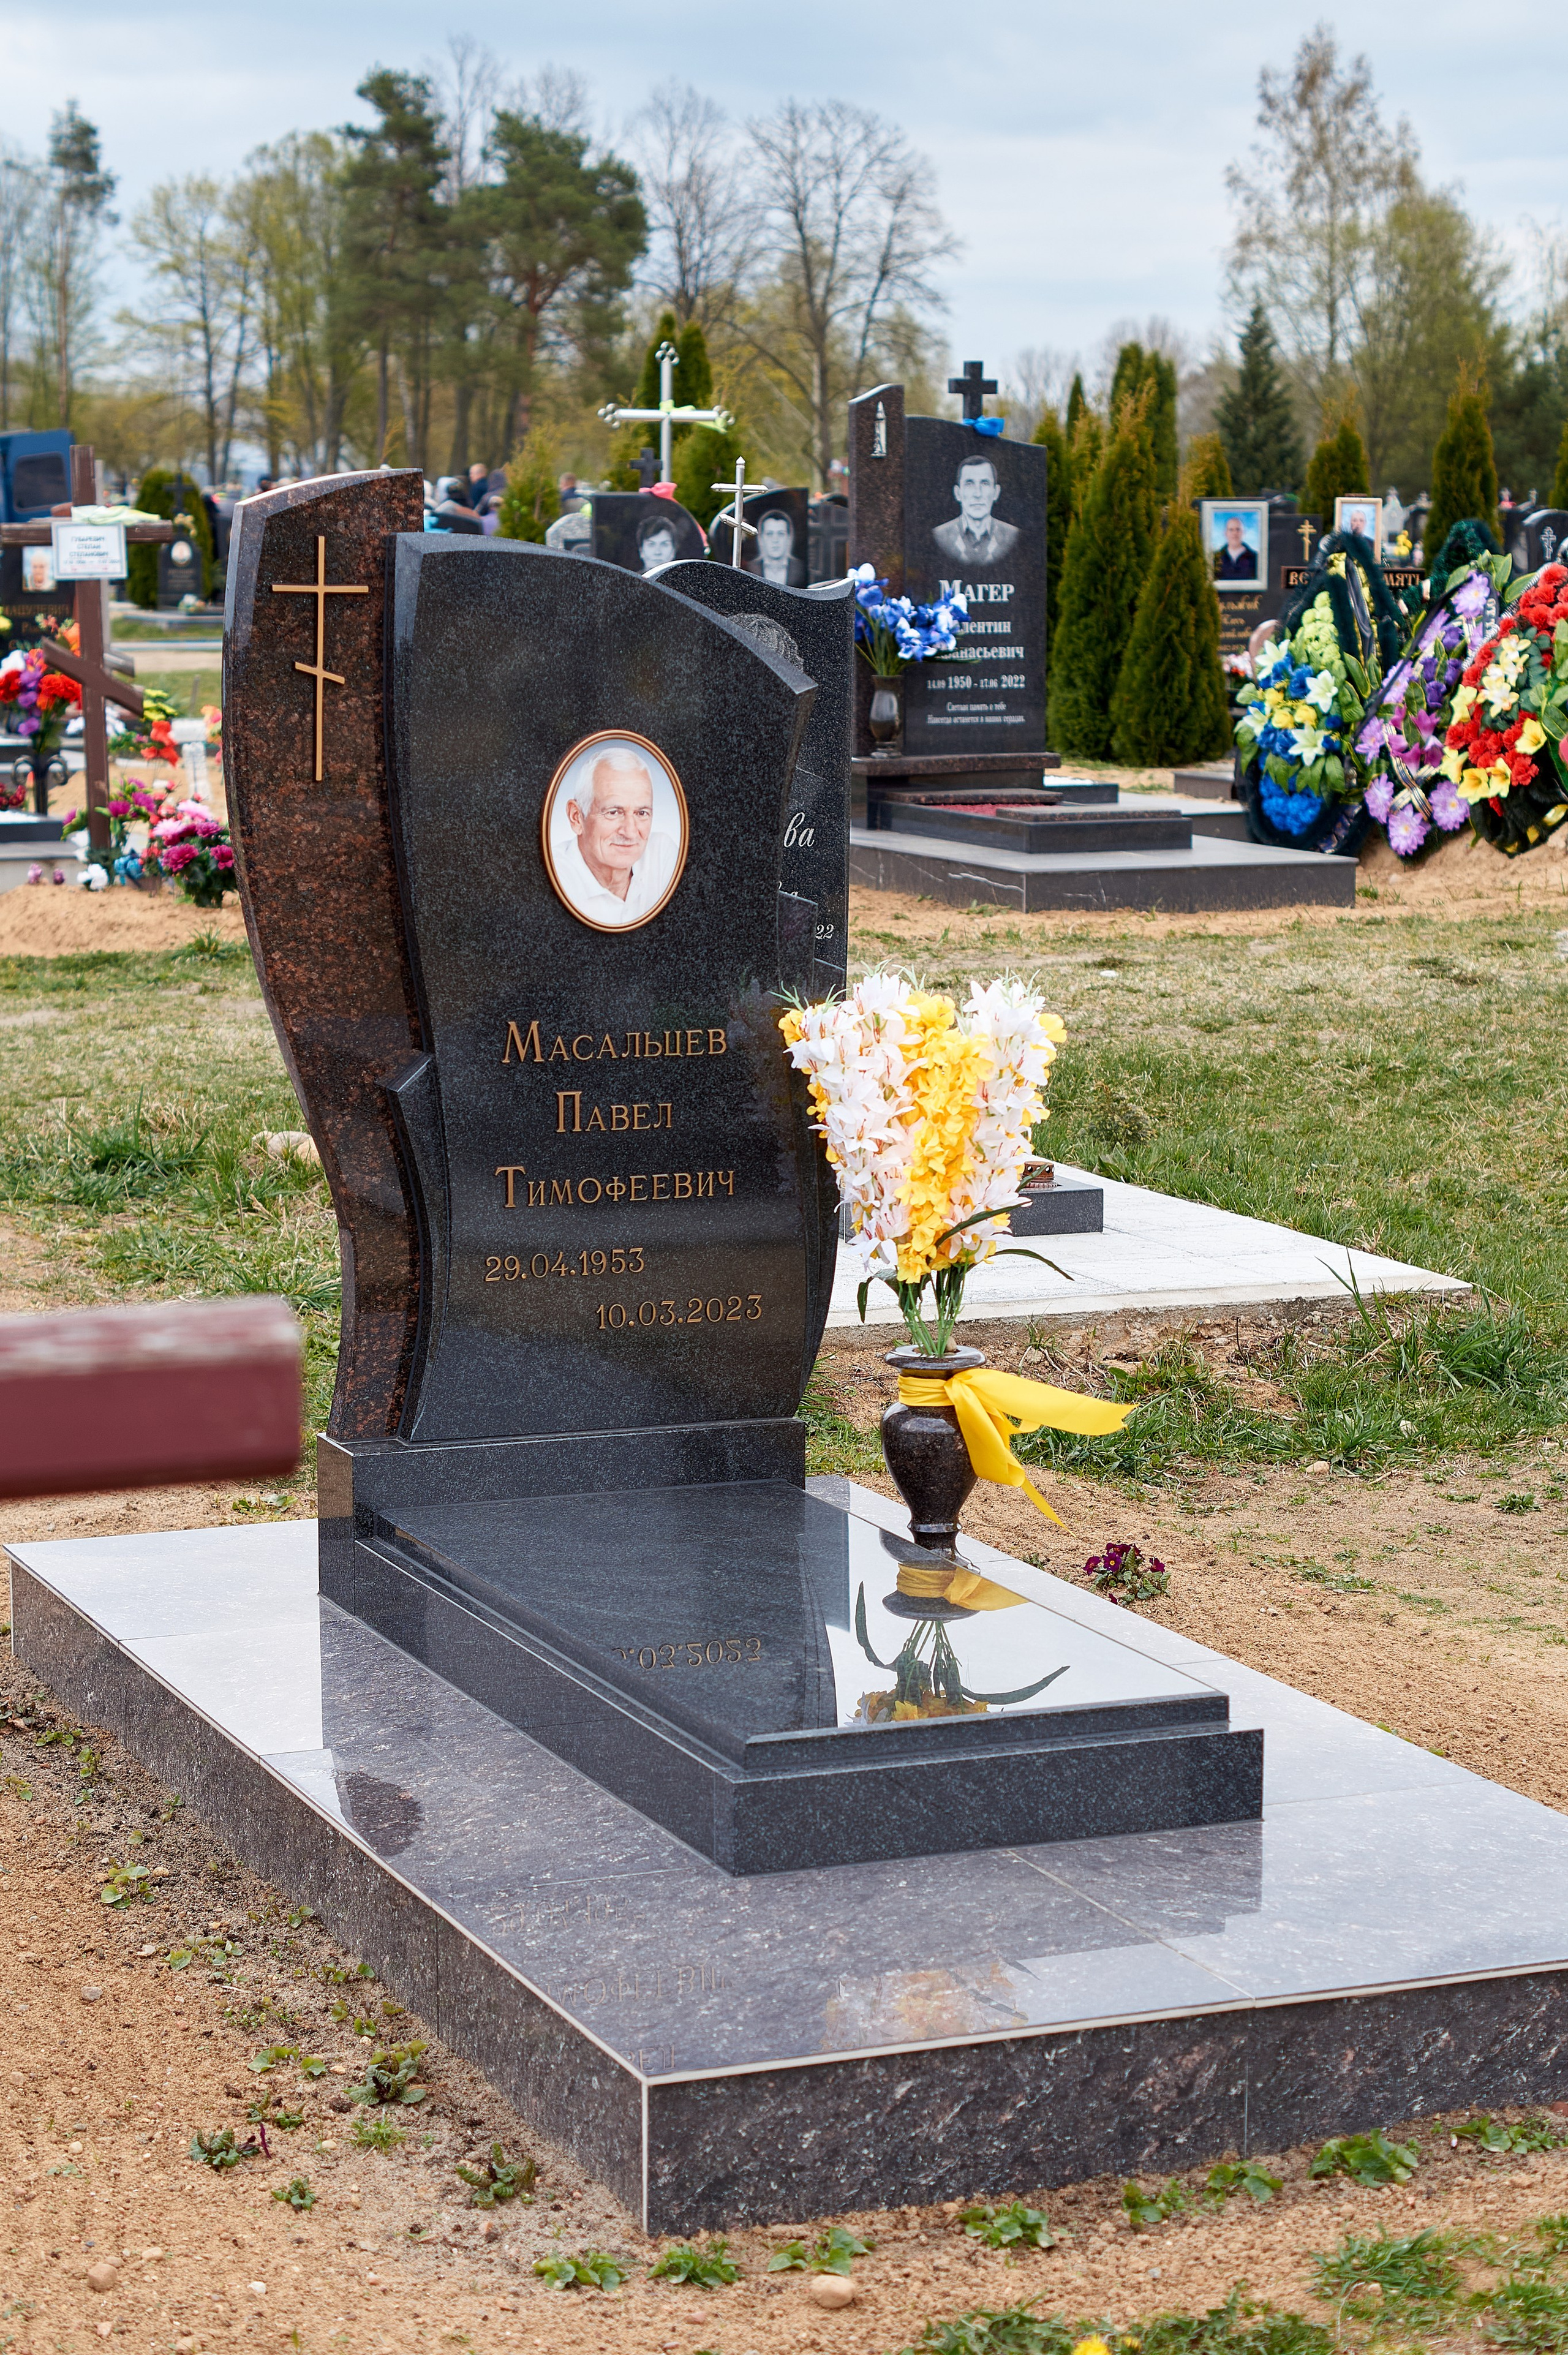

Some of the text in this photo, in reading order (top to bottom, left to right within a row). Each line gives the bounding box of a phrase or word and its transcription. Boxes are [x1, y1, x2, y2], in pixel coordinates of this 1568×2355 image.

[938, 579, 1015, 603] МАГЕР
[957, 621, 1012, 633] лентин
[927, 680, 946, 688] 14.09
[948, 676, 972, 688] 1950
[979, 679, 998, 688] 17.06
[1001, 674, 1025, 688] 2022
[501, 1020, 728, 1064] МАСАЛЬЦЕВ
[555, 1090, 673, 1133] ПАВЕЛ
[494, 1165, 735, 1208] ТИМОФЕЕВИЧ
[484, 1247, 646, 1283] 29.04.1953
[596, 1294, 763, 1330] 10.03.2023
